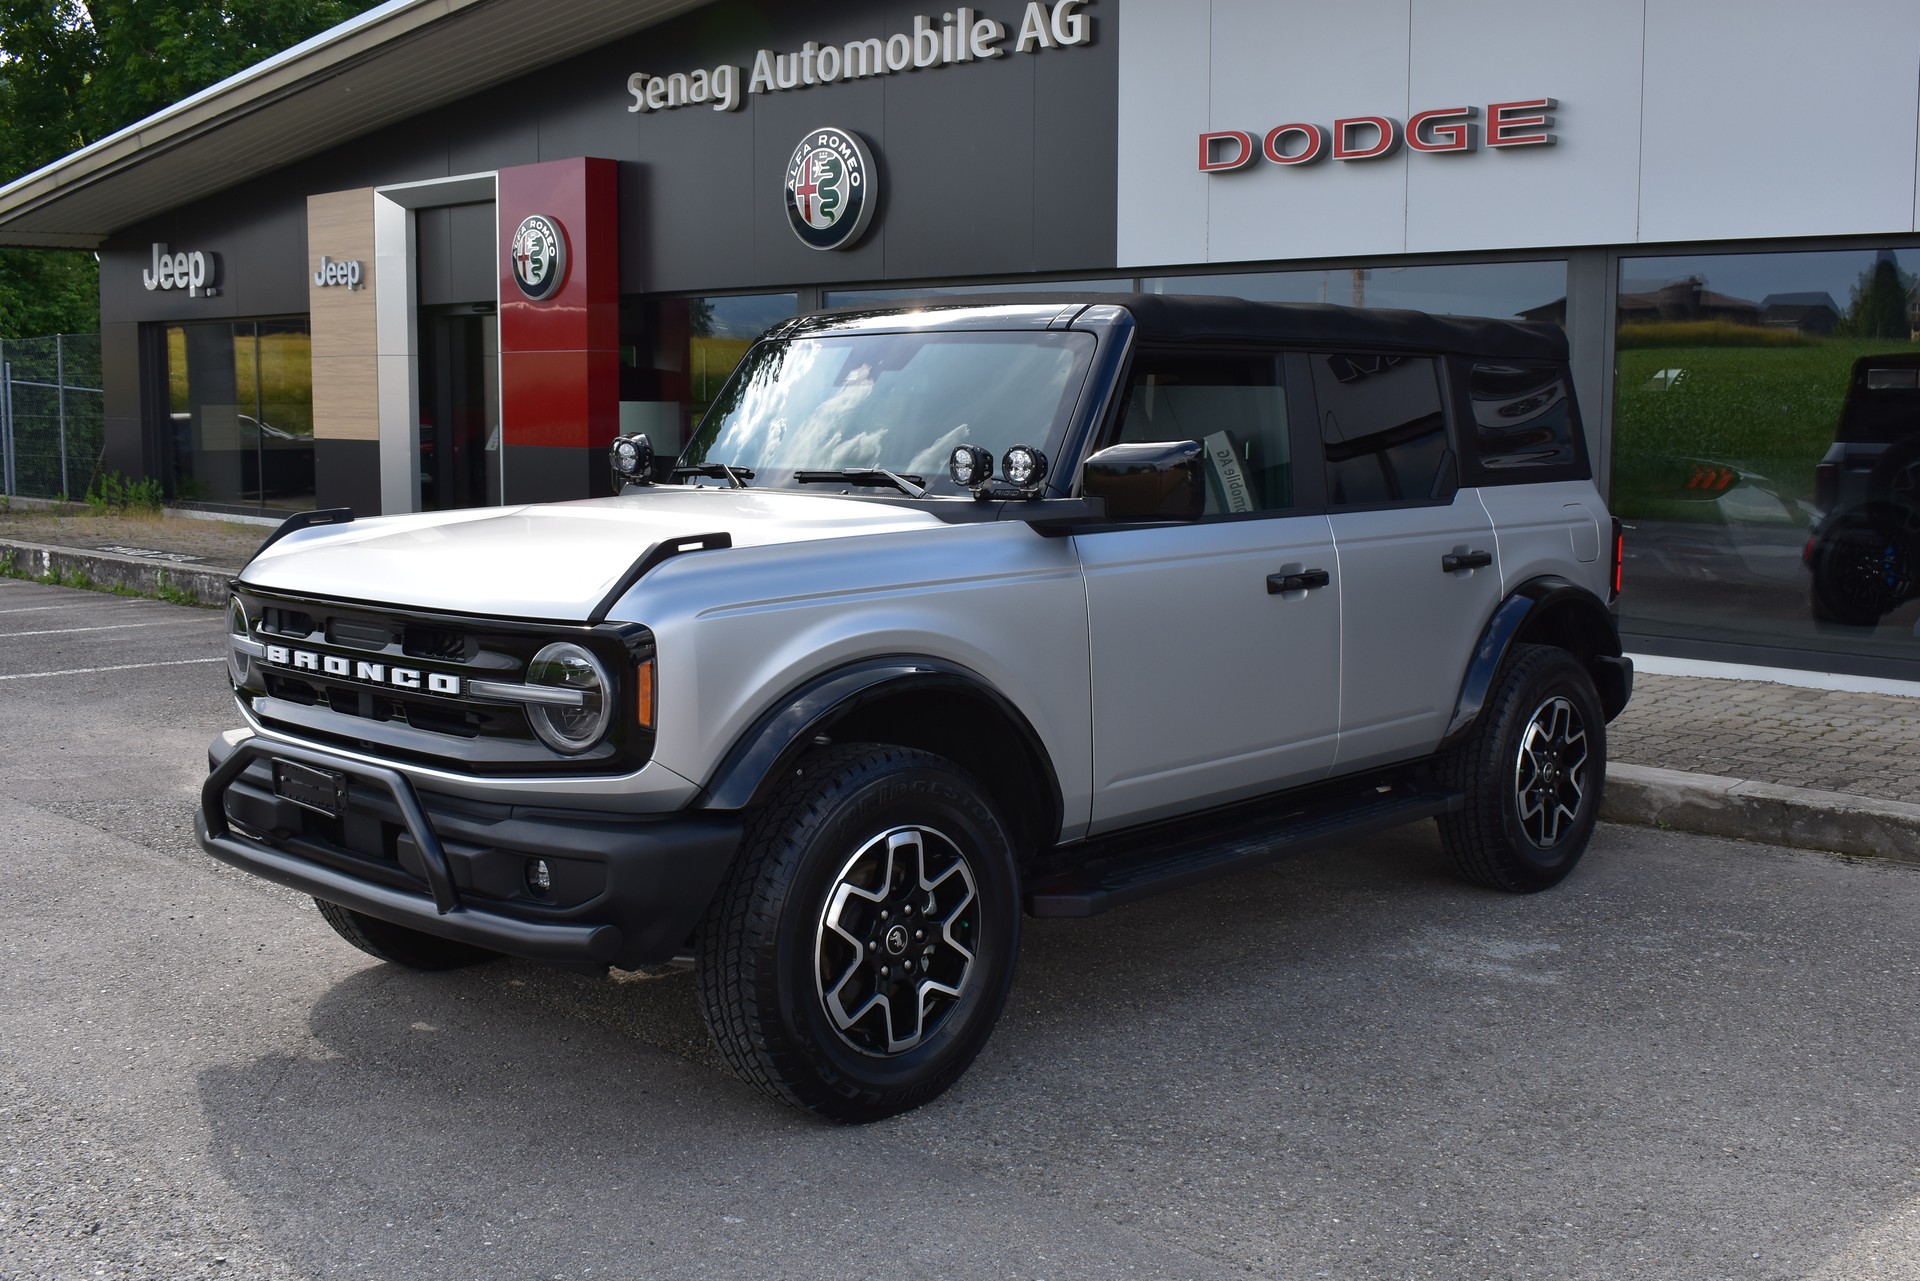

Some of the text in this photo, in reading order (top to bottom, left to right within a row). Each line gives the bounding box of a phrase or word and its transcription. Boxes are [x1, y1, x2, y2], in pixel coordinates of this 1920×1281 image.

[627, 0, 1091, 113] Senag Automobile AG
[1197, 97, 1558, 173] DODGE
[787, 134, 861, 192] ALFA ROMEO
[529, 219, 556, 257] ROMEO
[143, 243, 217, 298] Jeep
[313, 256, 365, 290] Jeep
[267, 644, 461, 695] BRONCO
